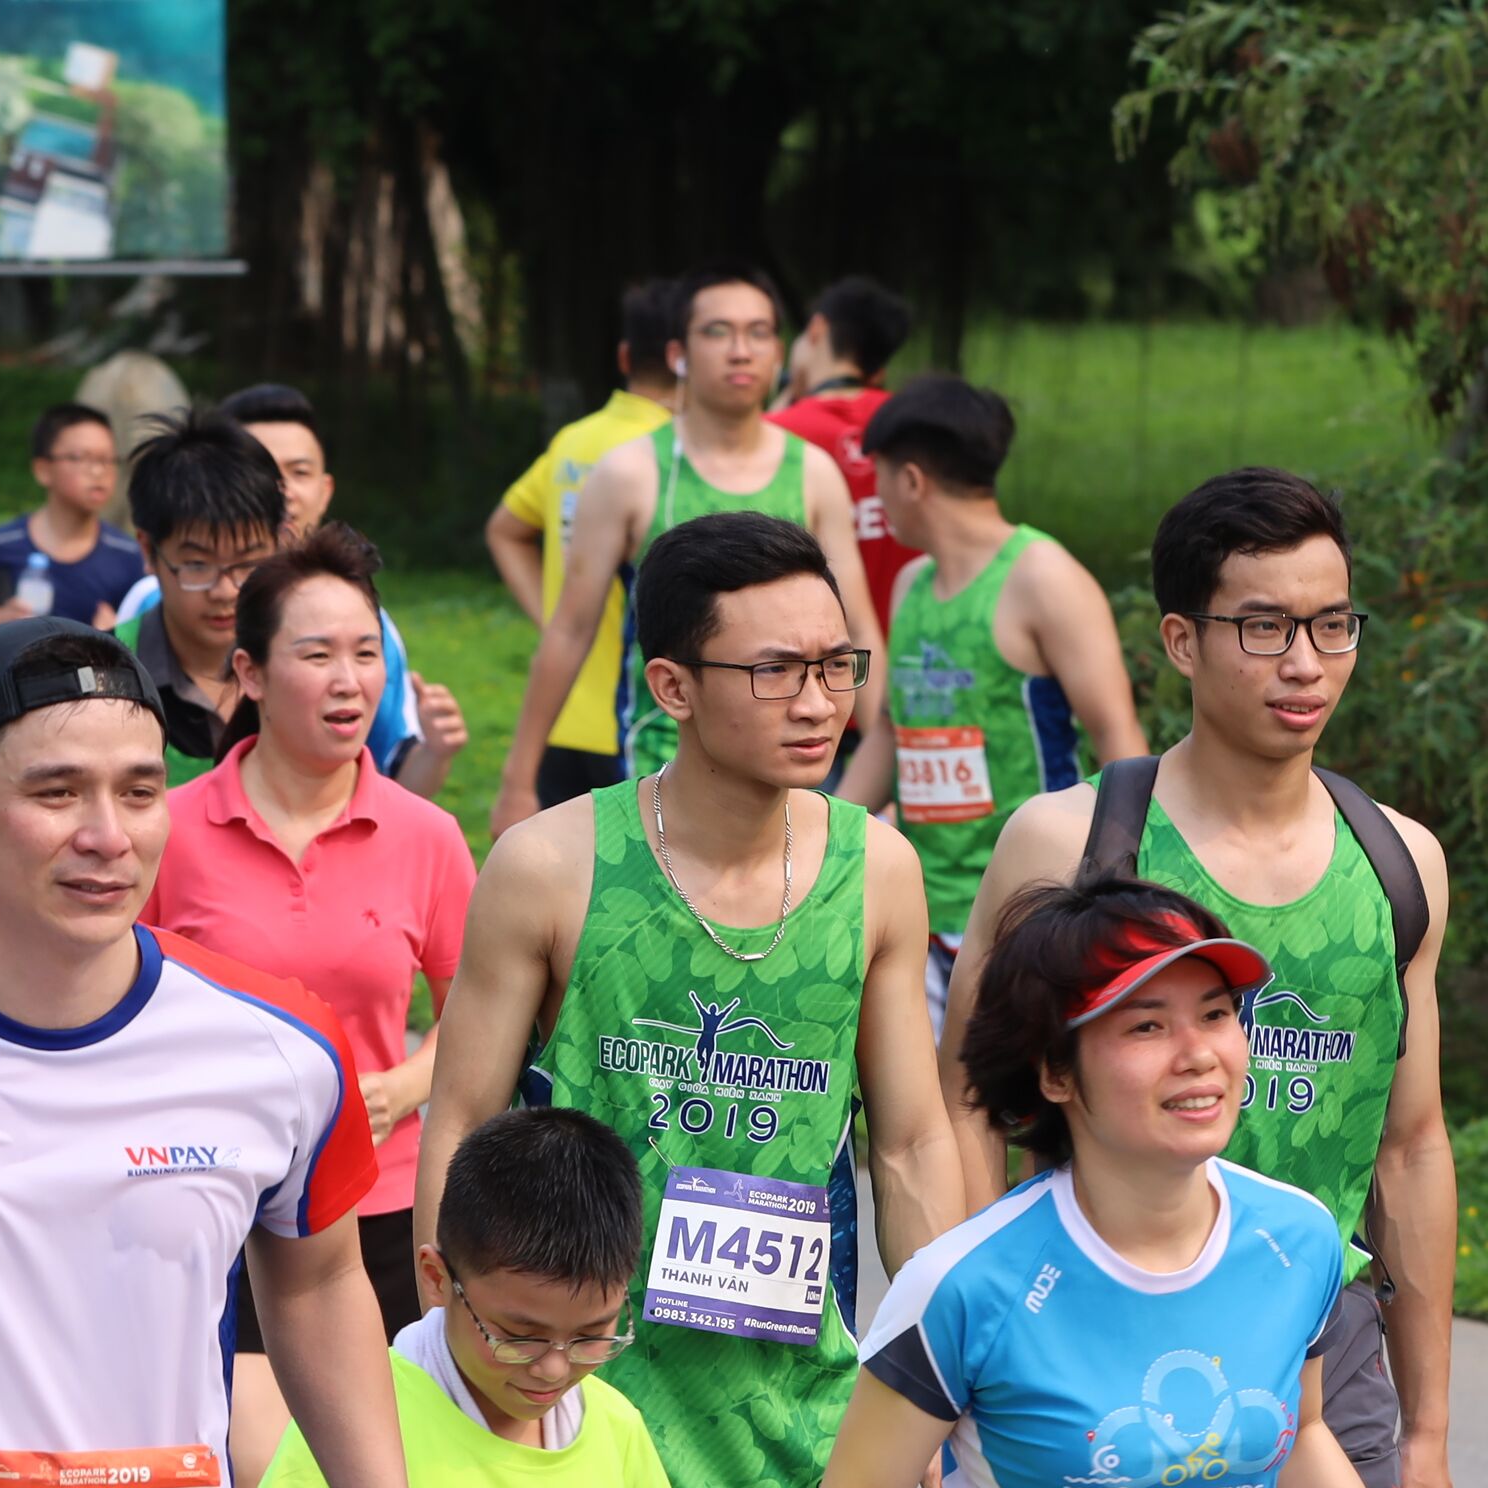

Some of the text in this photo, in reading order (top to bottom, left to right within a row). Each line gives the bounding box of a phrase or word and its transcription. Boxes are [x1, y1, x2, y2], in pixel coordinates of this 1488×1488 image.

[898, 757, 974, 785] 3816
[1251, 1024, 1357, 1064] MARATHON
[598, 1035, 831, 1094] ECOPARK MARATHON
[649, 1091, 779, 1144] 2019
[124, 1145, 218, 1166] VNPAY
[127, 1167, 179, 1177] RUNNING
[747, 1198, 816, 1214] MARATHON 2019
[749, 1191, 789, 1203] ECOPARK
[666, 1216, 824, 1282] M4512
[661, 1267, 749, 1292] THANH VÂN
[655, 1297, 689, 1308] HOTLINE
[654, 1307, 736, 1330] 0983.342.195
[60, 1467, 107, 1478] ECOPARK
[60, 1465, 152, 1486] MARATHON 2019
